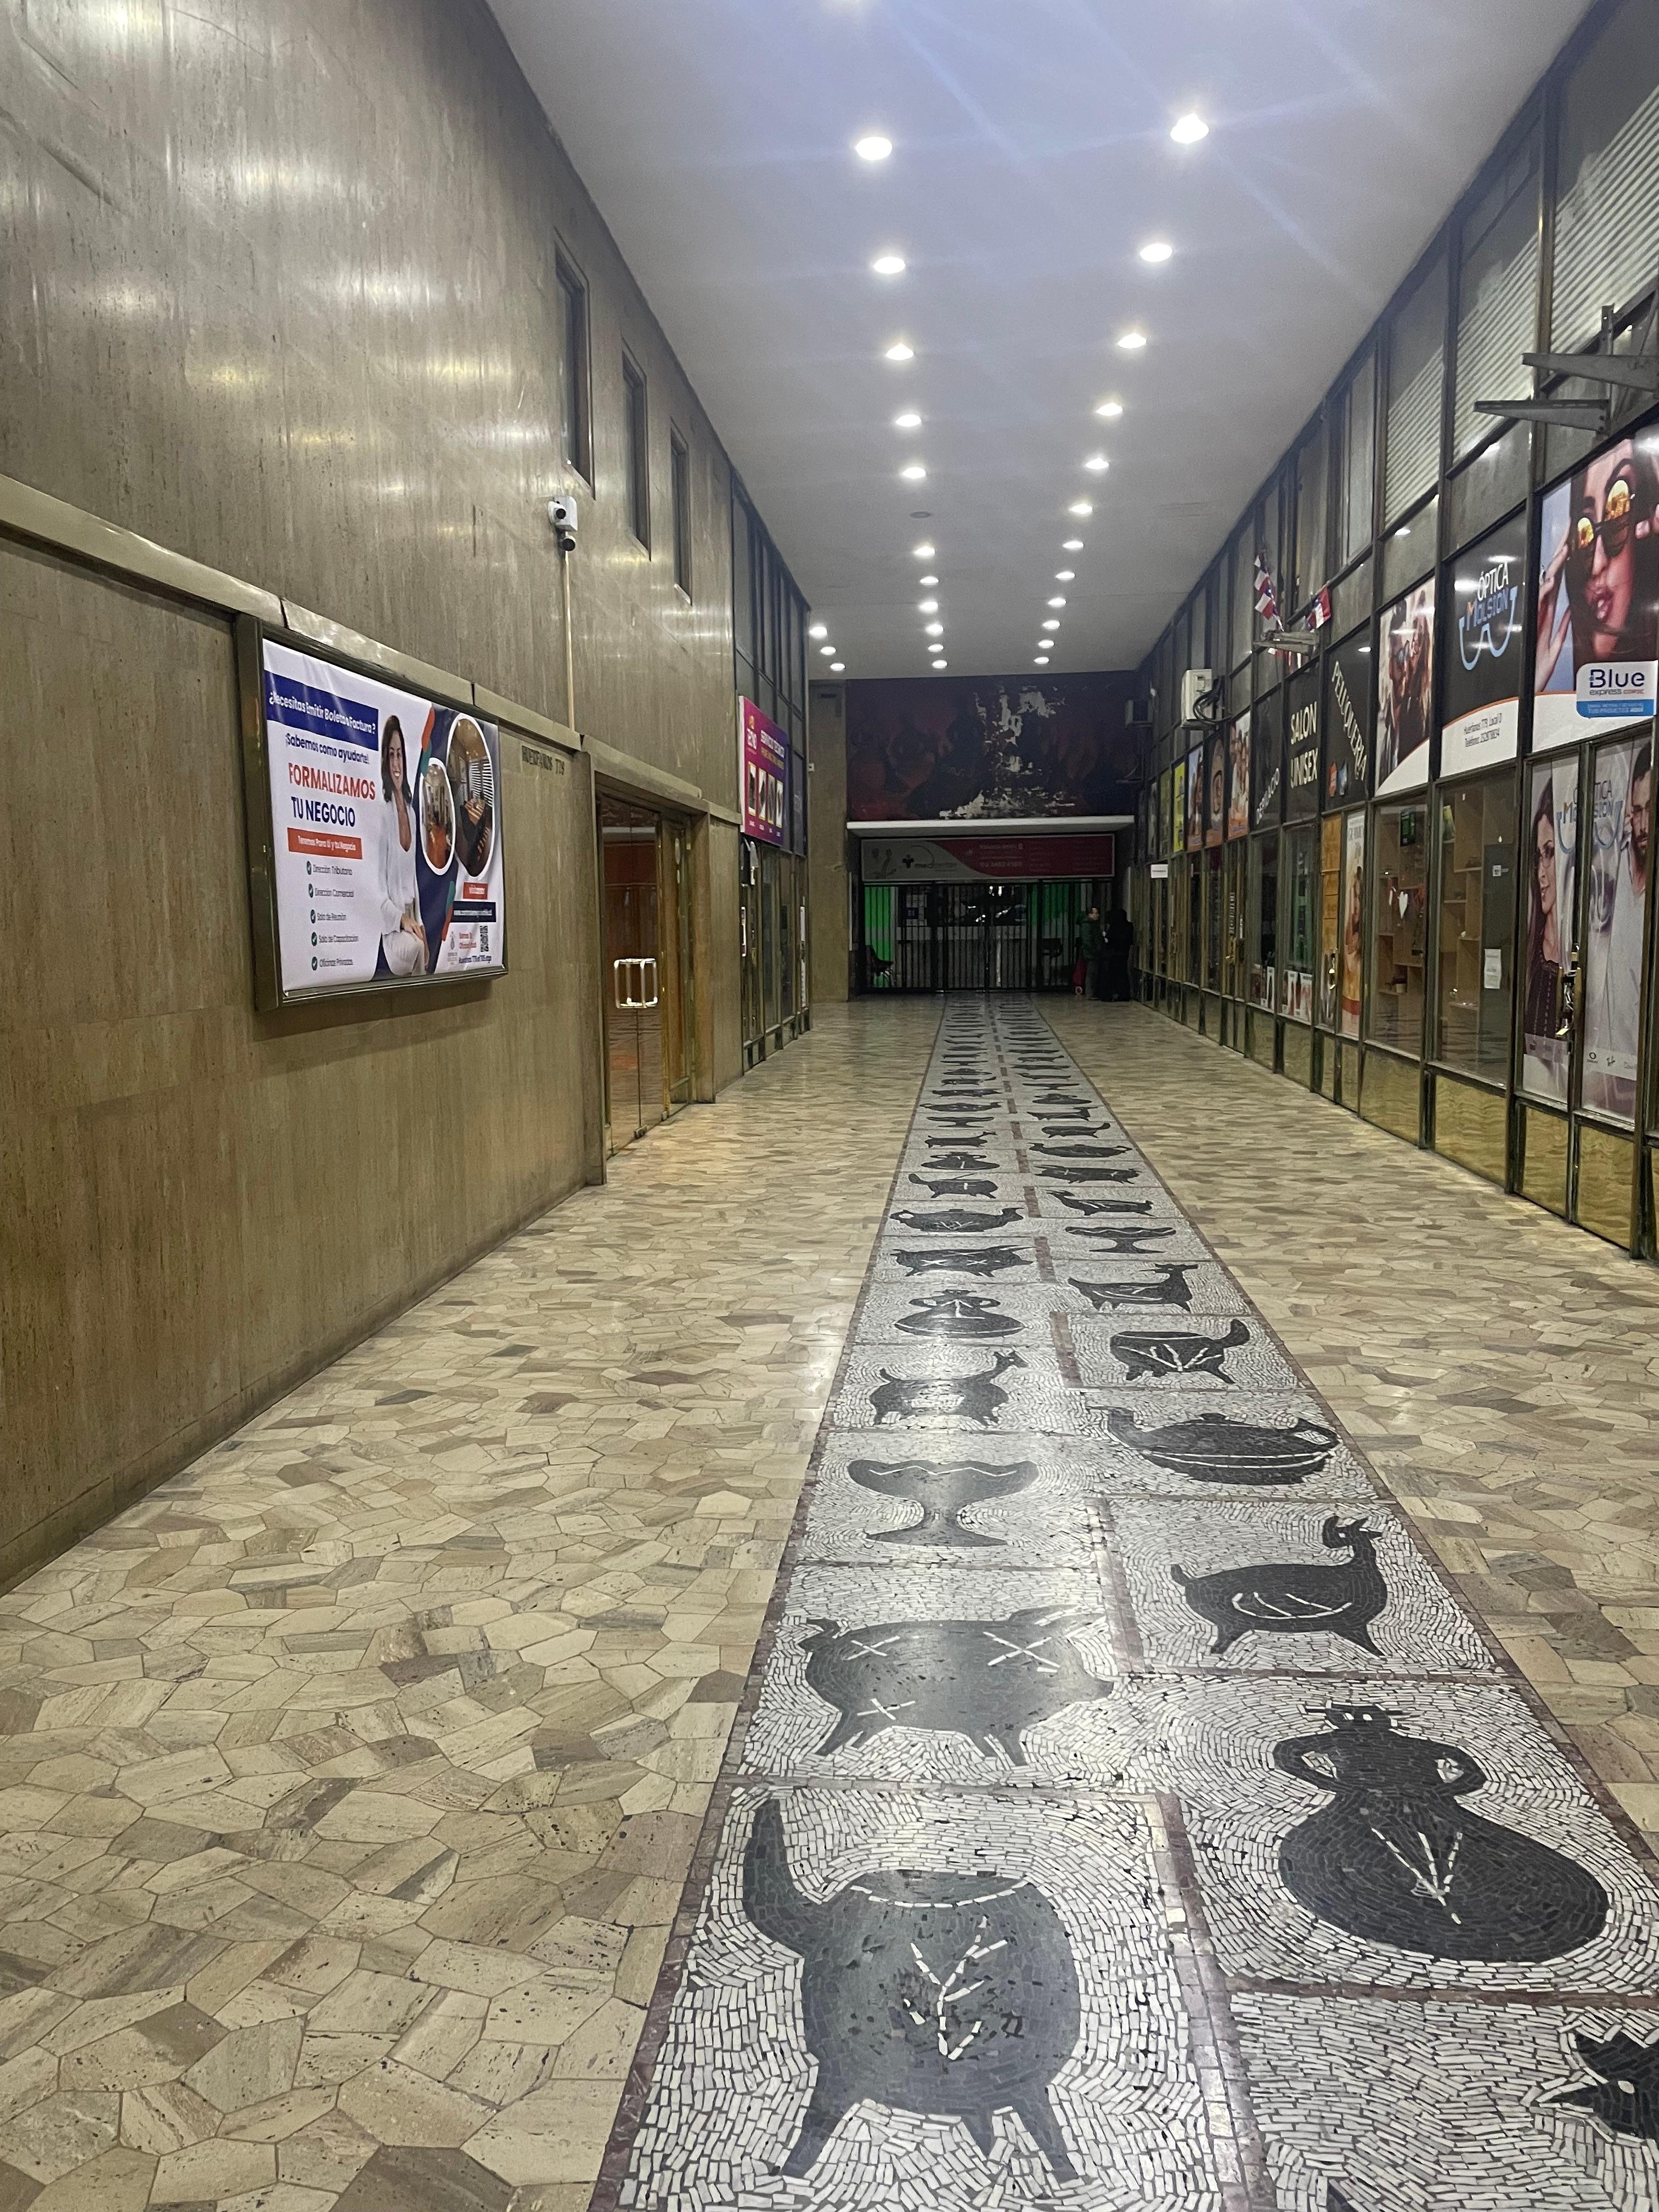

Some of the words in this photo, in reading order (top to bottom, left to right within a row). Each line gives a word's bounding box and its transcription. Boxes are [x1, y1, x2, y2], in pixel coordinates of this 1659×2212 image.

[1477, 561, 1509, 601] ÓPTICA
[1589, 669, 1645, 688] Blue
[1291, 701, 1317, 745] SALON
[319, 744, 337, 757] como
[1291, 747, 1318, 789] UNISEX
[288, 762, 376, 800] FORMALIZAMOS
[291, 796, 304, 819] TU
[306, 799, 356, 827] NEGOCIO
